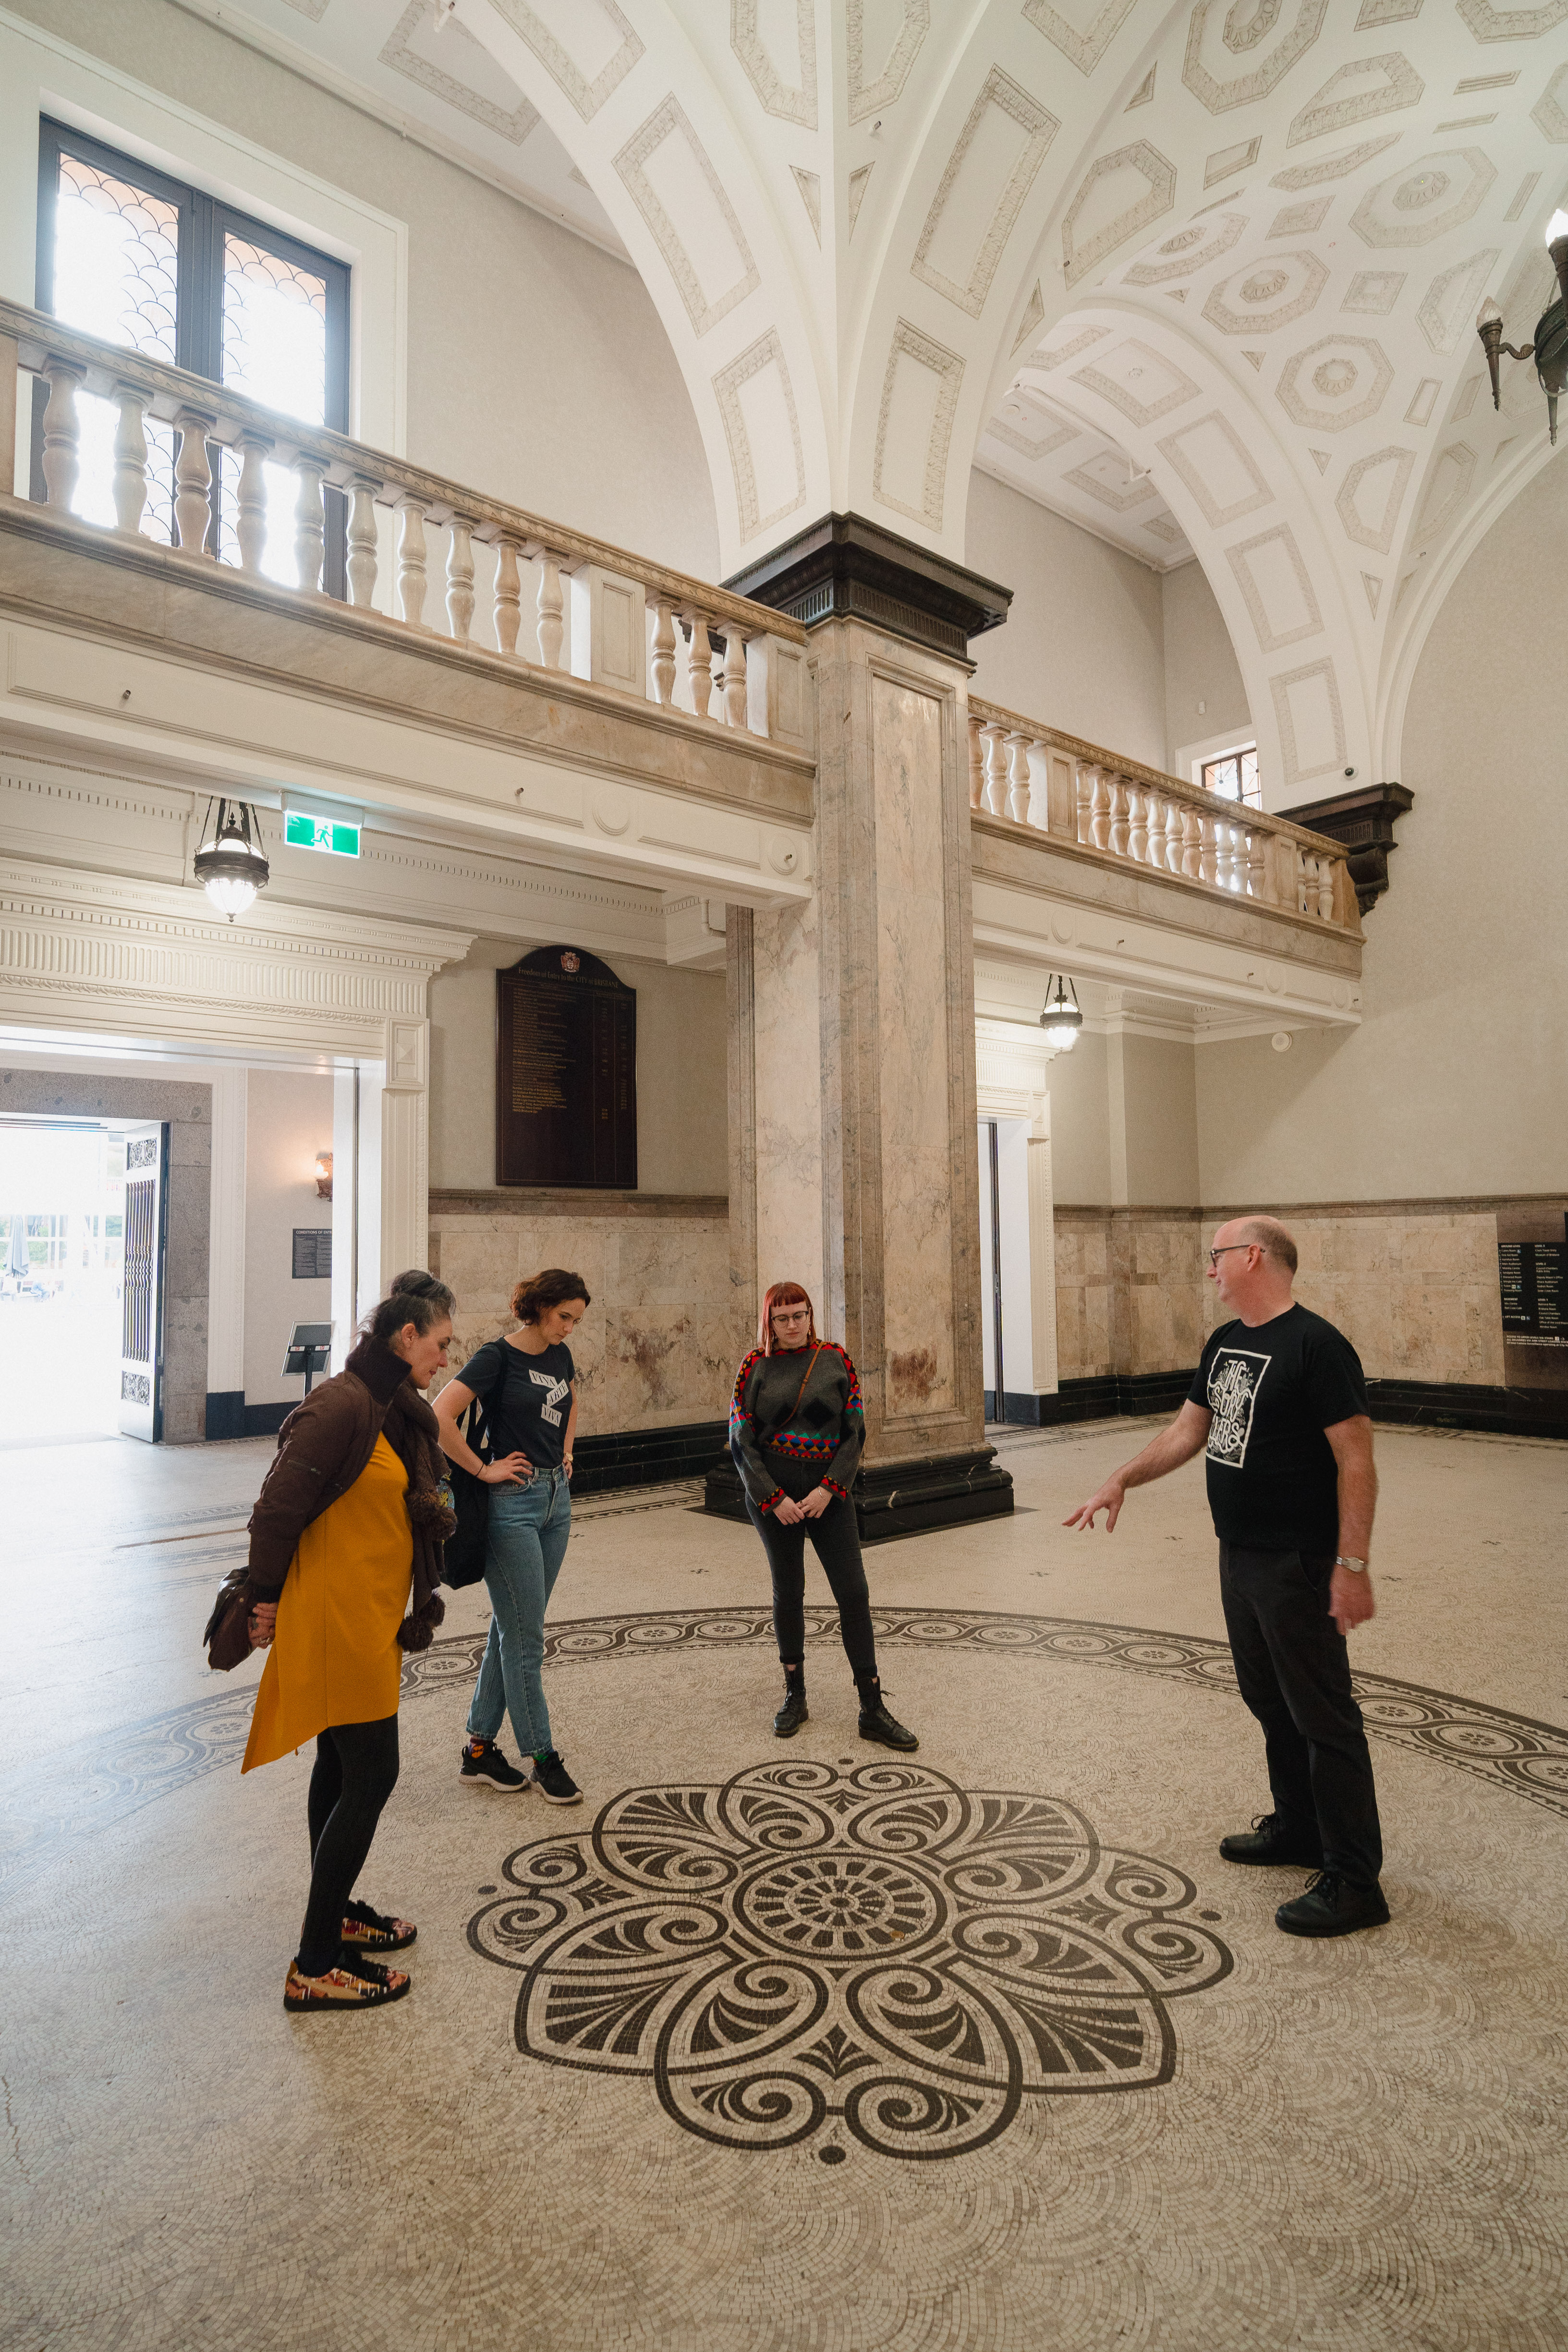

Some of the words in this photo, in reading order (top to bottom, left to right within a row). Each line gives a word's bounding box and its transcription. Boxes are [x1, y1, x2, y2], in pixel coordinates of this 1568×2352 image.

[519, 967, 541, 977] Freedom
[547, 971, 560, 981] Entry
[575, 975, 588, 983] CITY
[594, 978, 619, 988] BRISBANE
[532, 1372, 556, 1386] VIVA
[1225, 1359, 1247, 1391] THE
[548, 1383, 567, 1405] ARTE
[544, 1407, 559, 1424] VIVA
